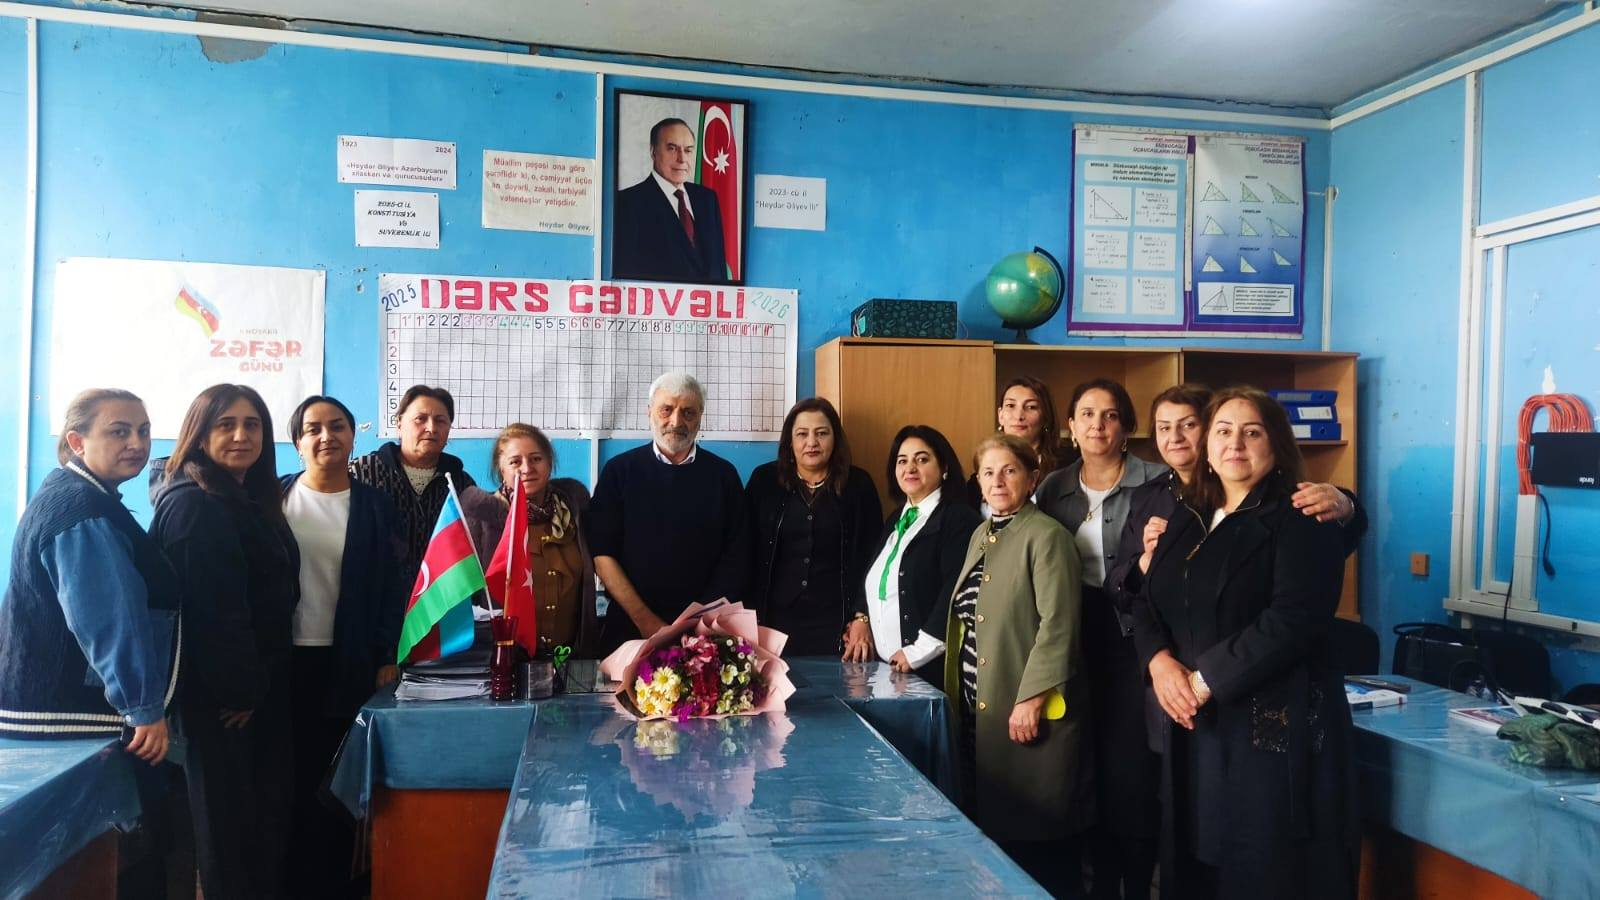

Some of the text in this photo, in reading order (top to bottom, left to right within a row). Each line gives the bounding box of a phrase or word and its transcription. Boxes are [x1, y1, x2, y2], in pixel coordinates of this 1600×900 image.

[435, 146, 452, 154] 2024
[381, 283, 418, 313] 2025
[420, 278, 746, 320] DƏRS CƏDVƏLİ
[751, 291, 791, 320] 2026
[210, 338, 303, 359] ZƏFƏR
[389, 345, 398, 358] 2
[239, 358, 285, 373] GÜNÜ
[389, 363, 397, 375] 3
[389, 381, 397, 391] 4
[389, 398, 398, 410] 5
